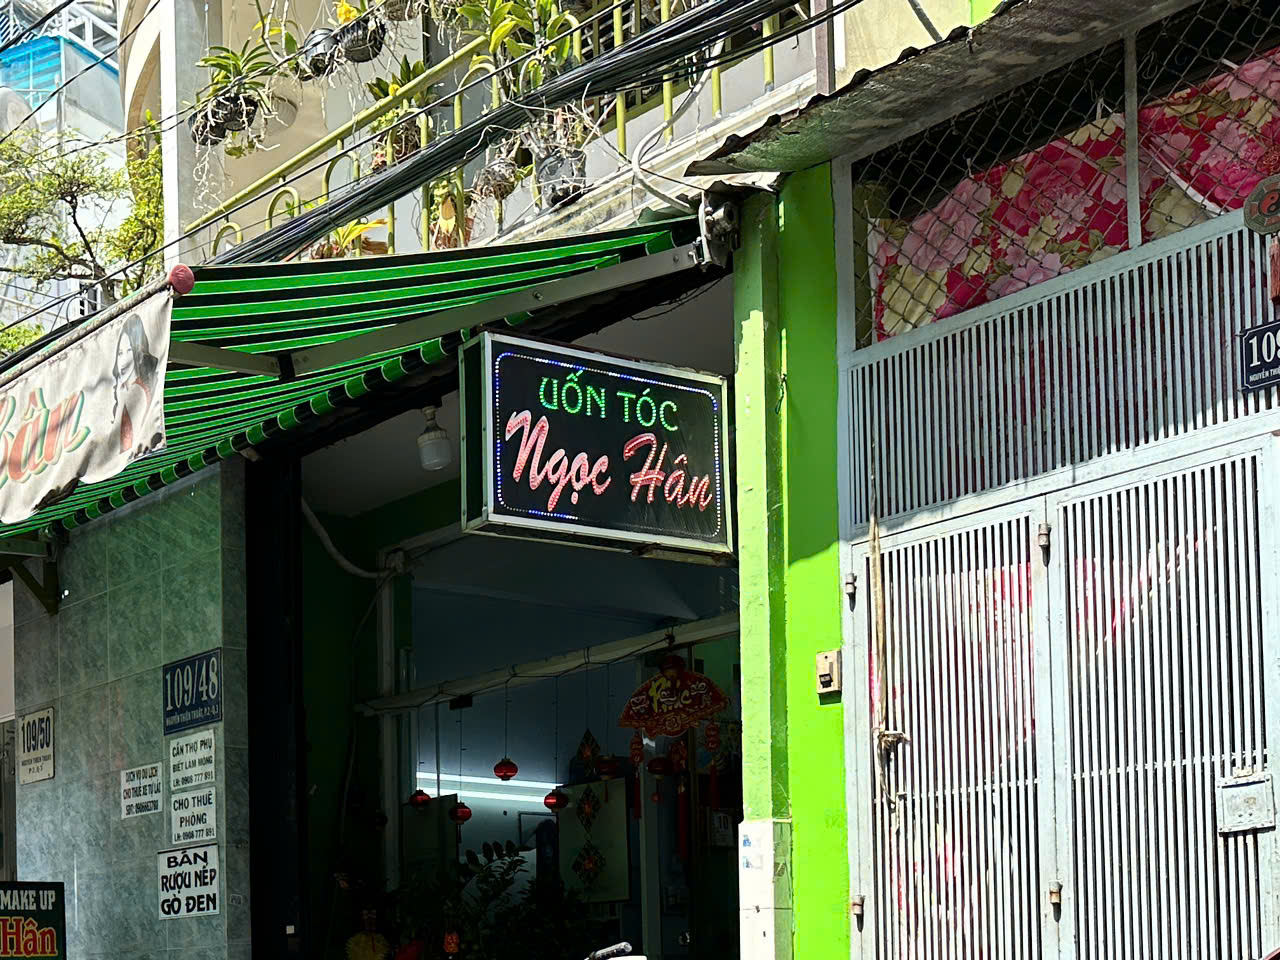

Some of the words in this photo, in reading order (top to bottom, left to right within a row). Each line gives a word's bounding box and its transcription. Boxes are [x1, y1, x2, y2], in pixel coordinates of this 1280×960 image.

[1249, 329, 1280, 367] 10
[539, 370, 606, 418] UỐN
[617, 388, 678, 431] TÓC
[505, 409, 612, 512] Ngọc
[623, 433, 713, 512] Hân
[165, 656, 219, 711] 109/48
[22, 715, 51, 753] 109/50
[173, 797, 190, 812] CHO
[191, 790, 213, 808] THUÊ
[179, 811, 207, 828] PHÒNG
[167, 850, 208, 868] BÁN
[161, 871, 191, 894] RƯỢU
[194, 863, 217, 887] NẾP
[0, 890, 37, 910] MAKE
[39, 890, 56, 910] UP
[161, 894, 181, 915] GÒ
[185, 893, 217, 913] ĐEN
